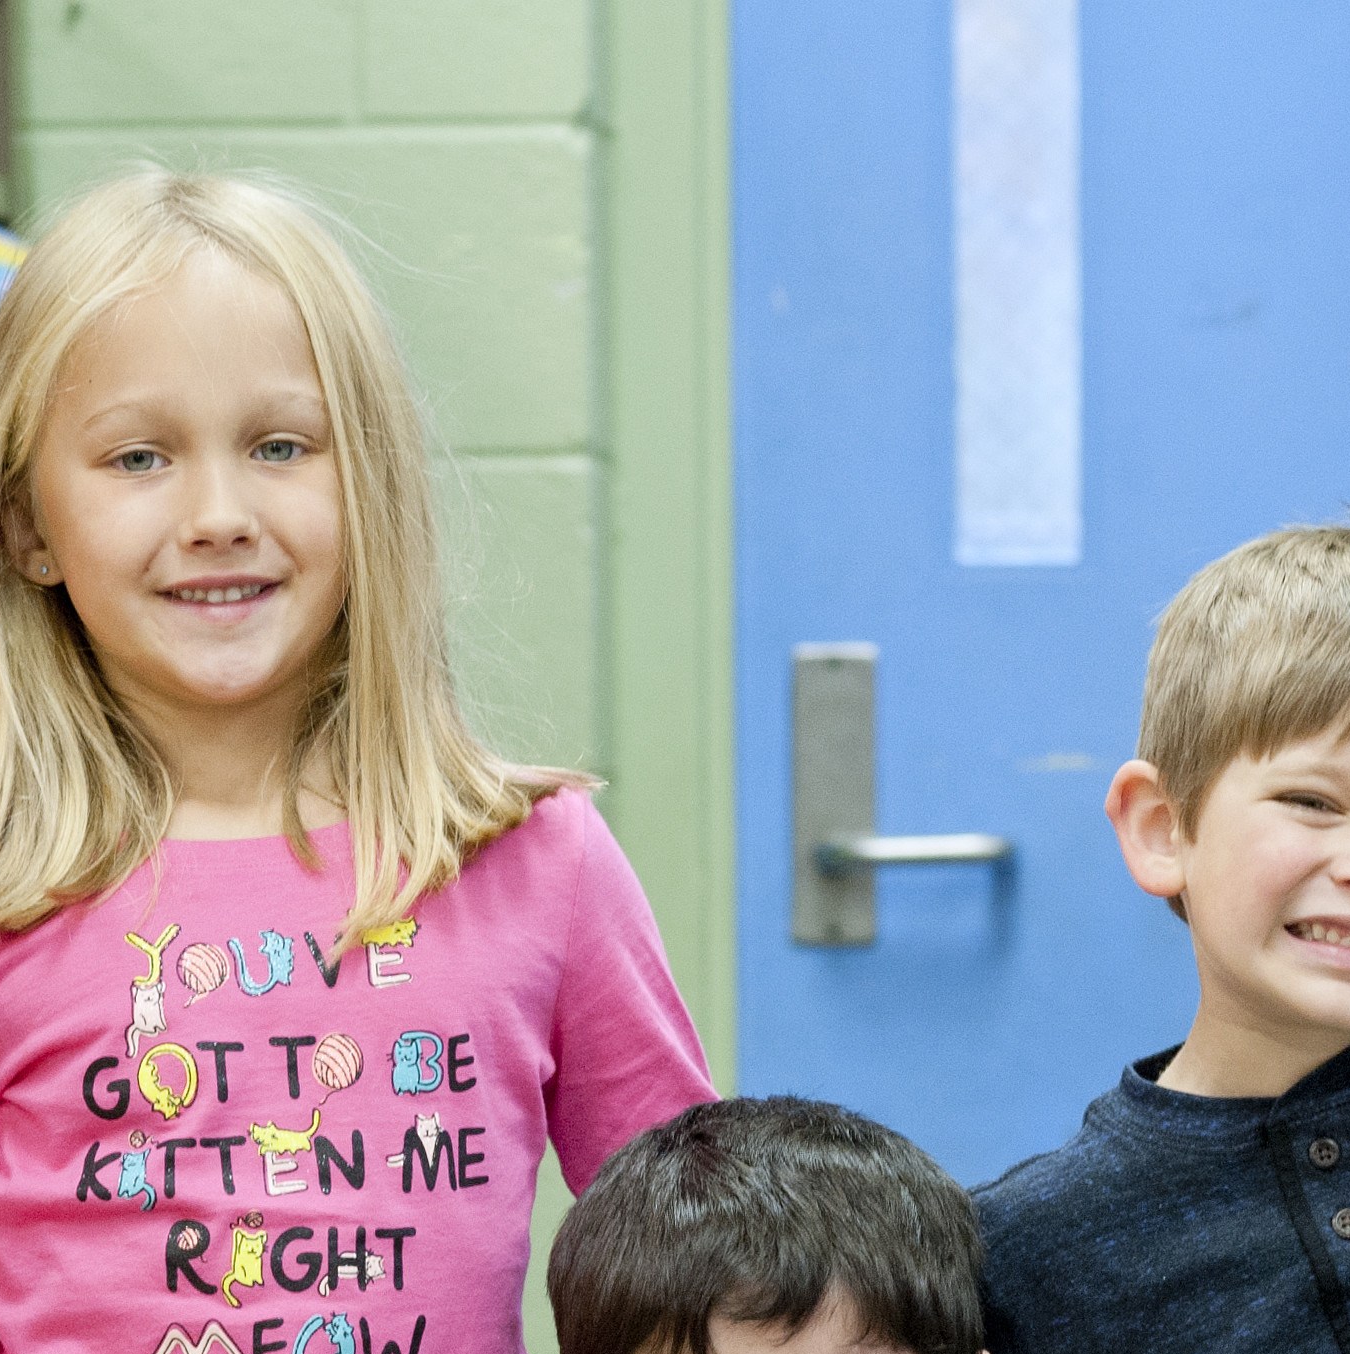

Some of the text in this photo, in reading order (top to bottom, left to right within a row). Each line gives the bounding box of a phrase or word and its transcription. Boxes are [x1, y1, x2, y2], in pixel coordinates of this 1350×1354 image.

[82, 1030, 477, 1120] GOT TO BE
[76, 1114, 490, 1208] KITTEN ME
[164, 1216, 417, 1305] RIGHT
